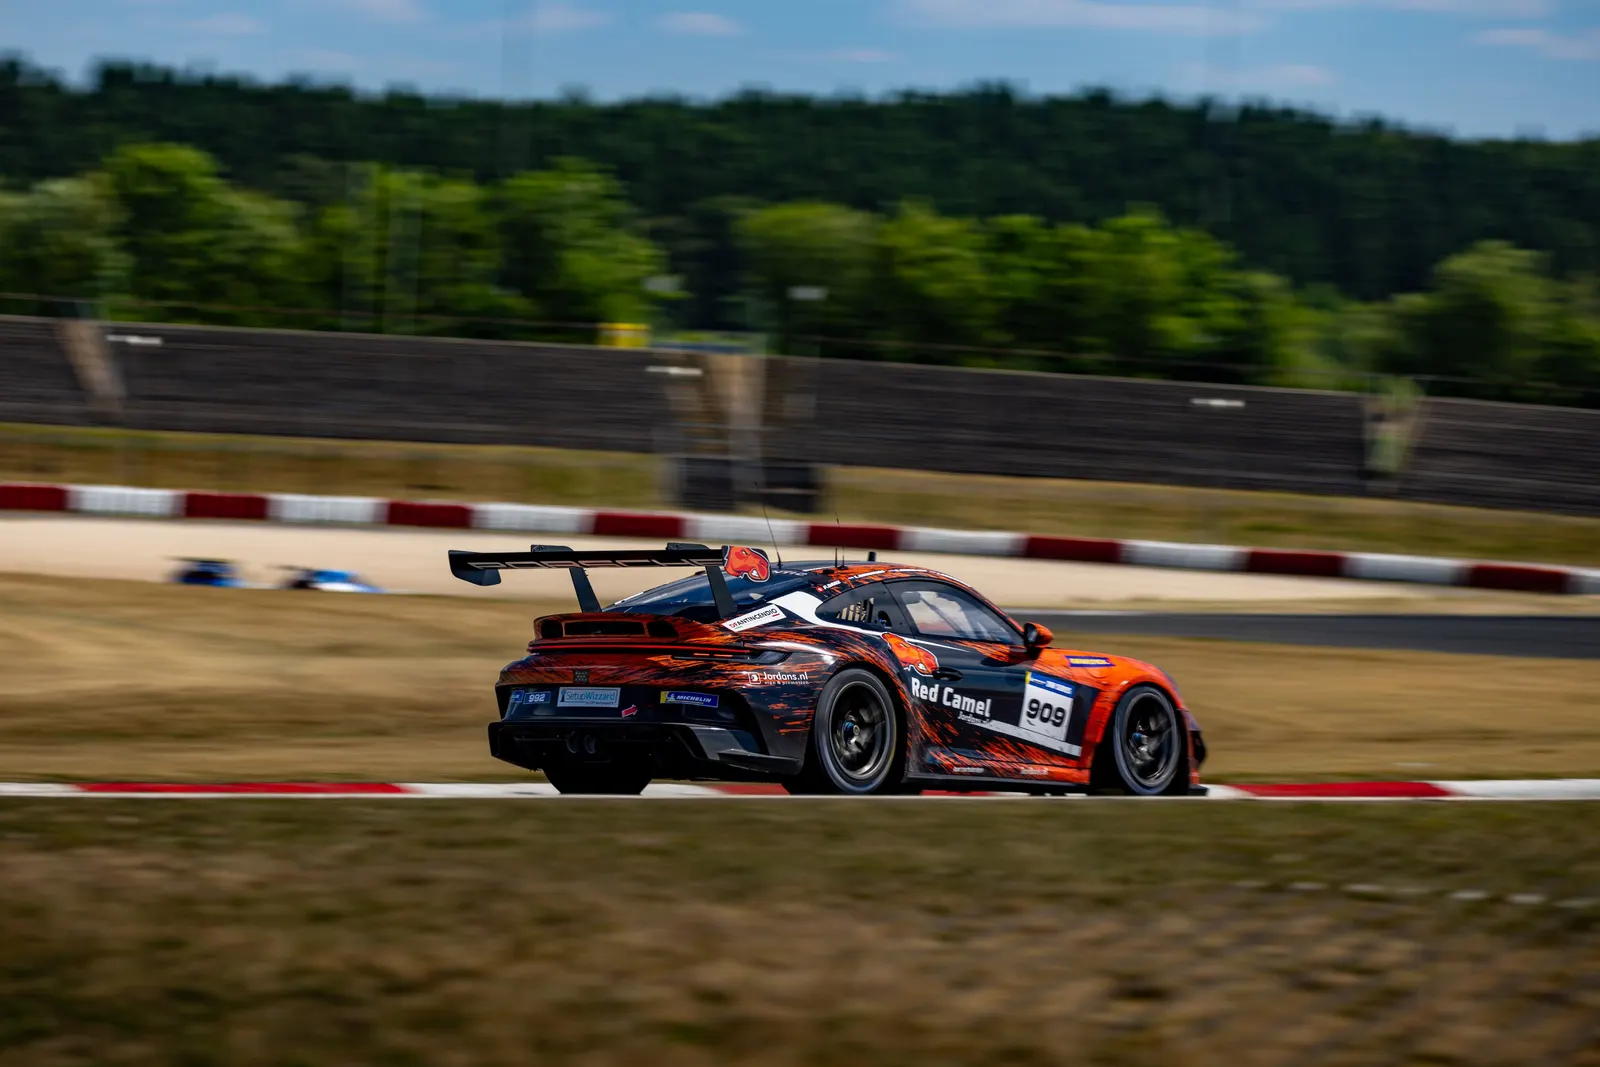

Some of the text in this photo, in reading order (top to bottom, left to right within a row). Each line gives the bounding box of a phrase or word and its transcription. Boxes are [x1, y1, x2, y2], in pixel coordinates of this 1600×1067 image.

[763, 671, 808, 680] Jordans.nl
[528, 693, 545, 702] 992
[566, 691, 615, 703] SetupWizzard
[676, 695, 712, 703] MICHELIN
[911, 677, 992, 717] Red Camel
[1025, 698, 1066, 727] 909
